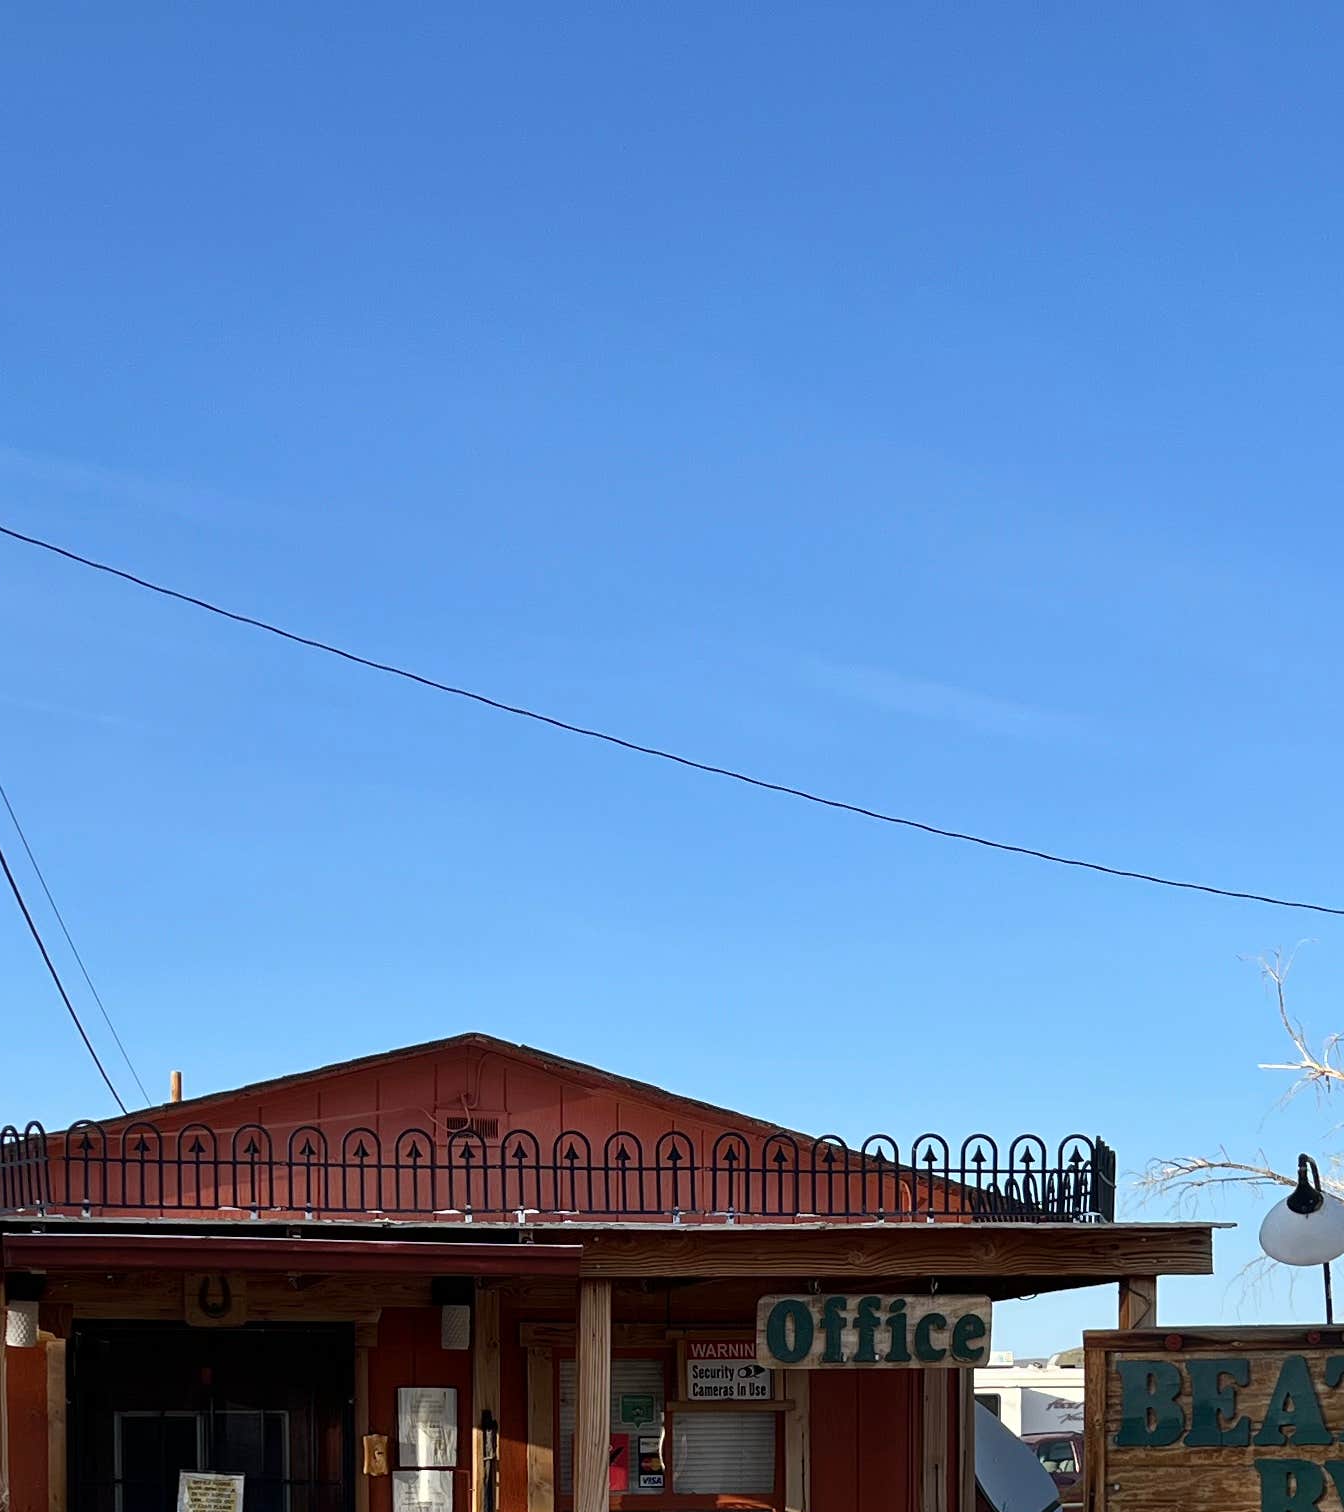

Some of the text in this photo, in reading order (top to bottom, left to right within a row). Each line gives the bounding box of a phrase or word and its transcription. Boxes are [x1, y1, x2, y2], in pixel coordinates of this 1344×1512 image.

[766, 1296, 986, 1363] Office
[690, 1343, 755, 1358] WARNIN
[692, 1364, 735, 1381] Security
[692, 1382, 766, 1397] Cameras In Use
[643, 1477, 662, 1485] VISA
